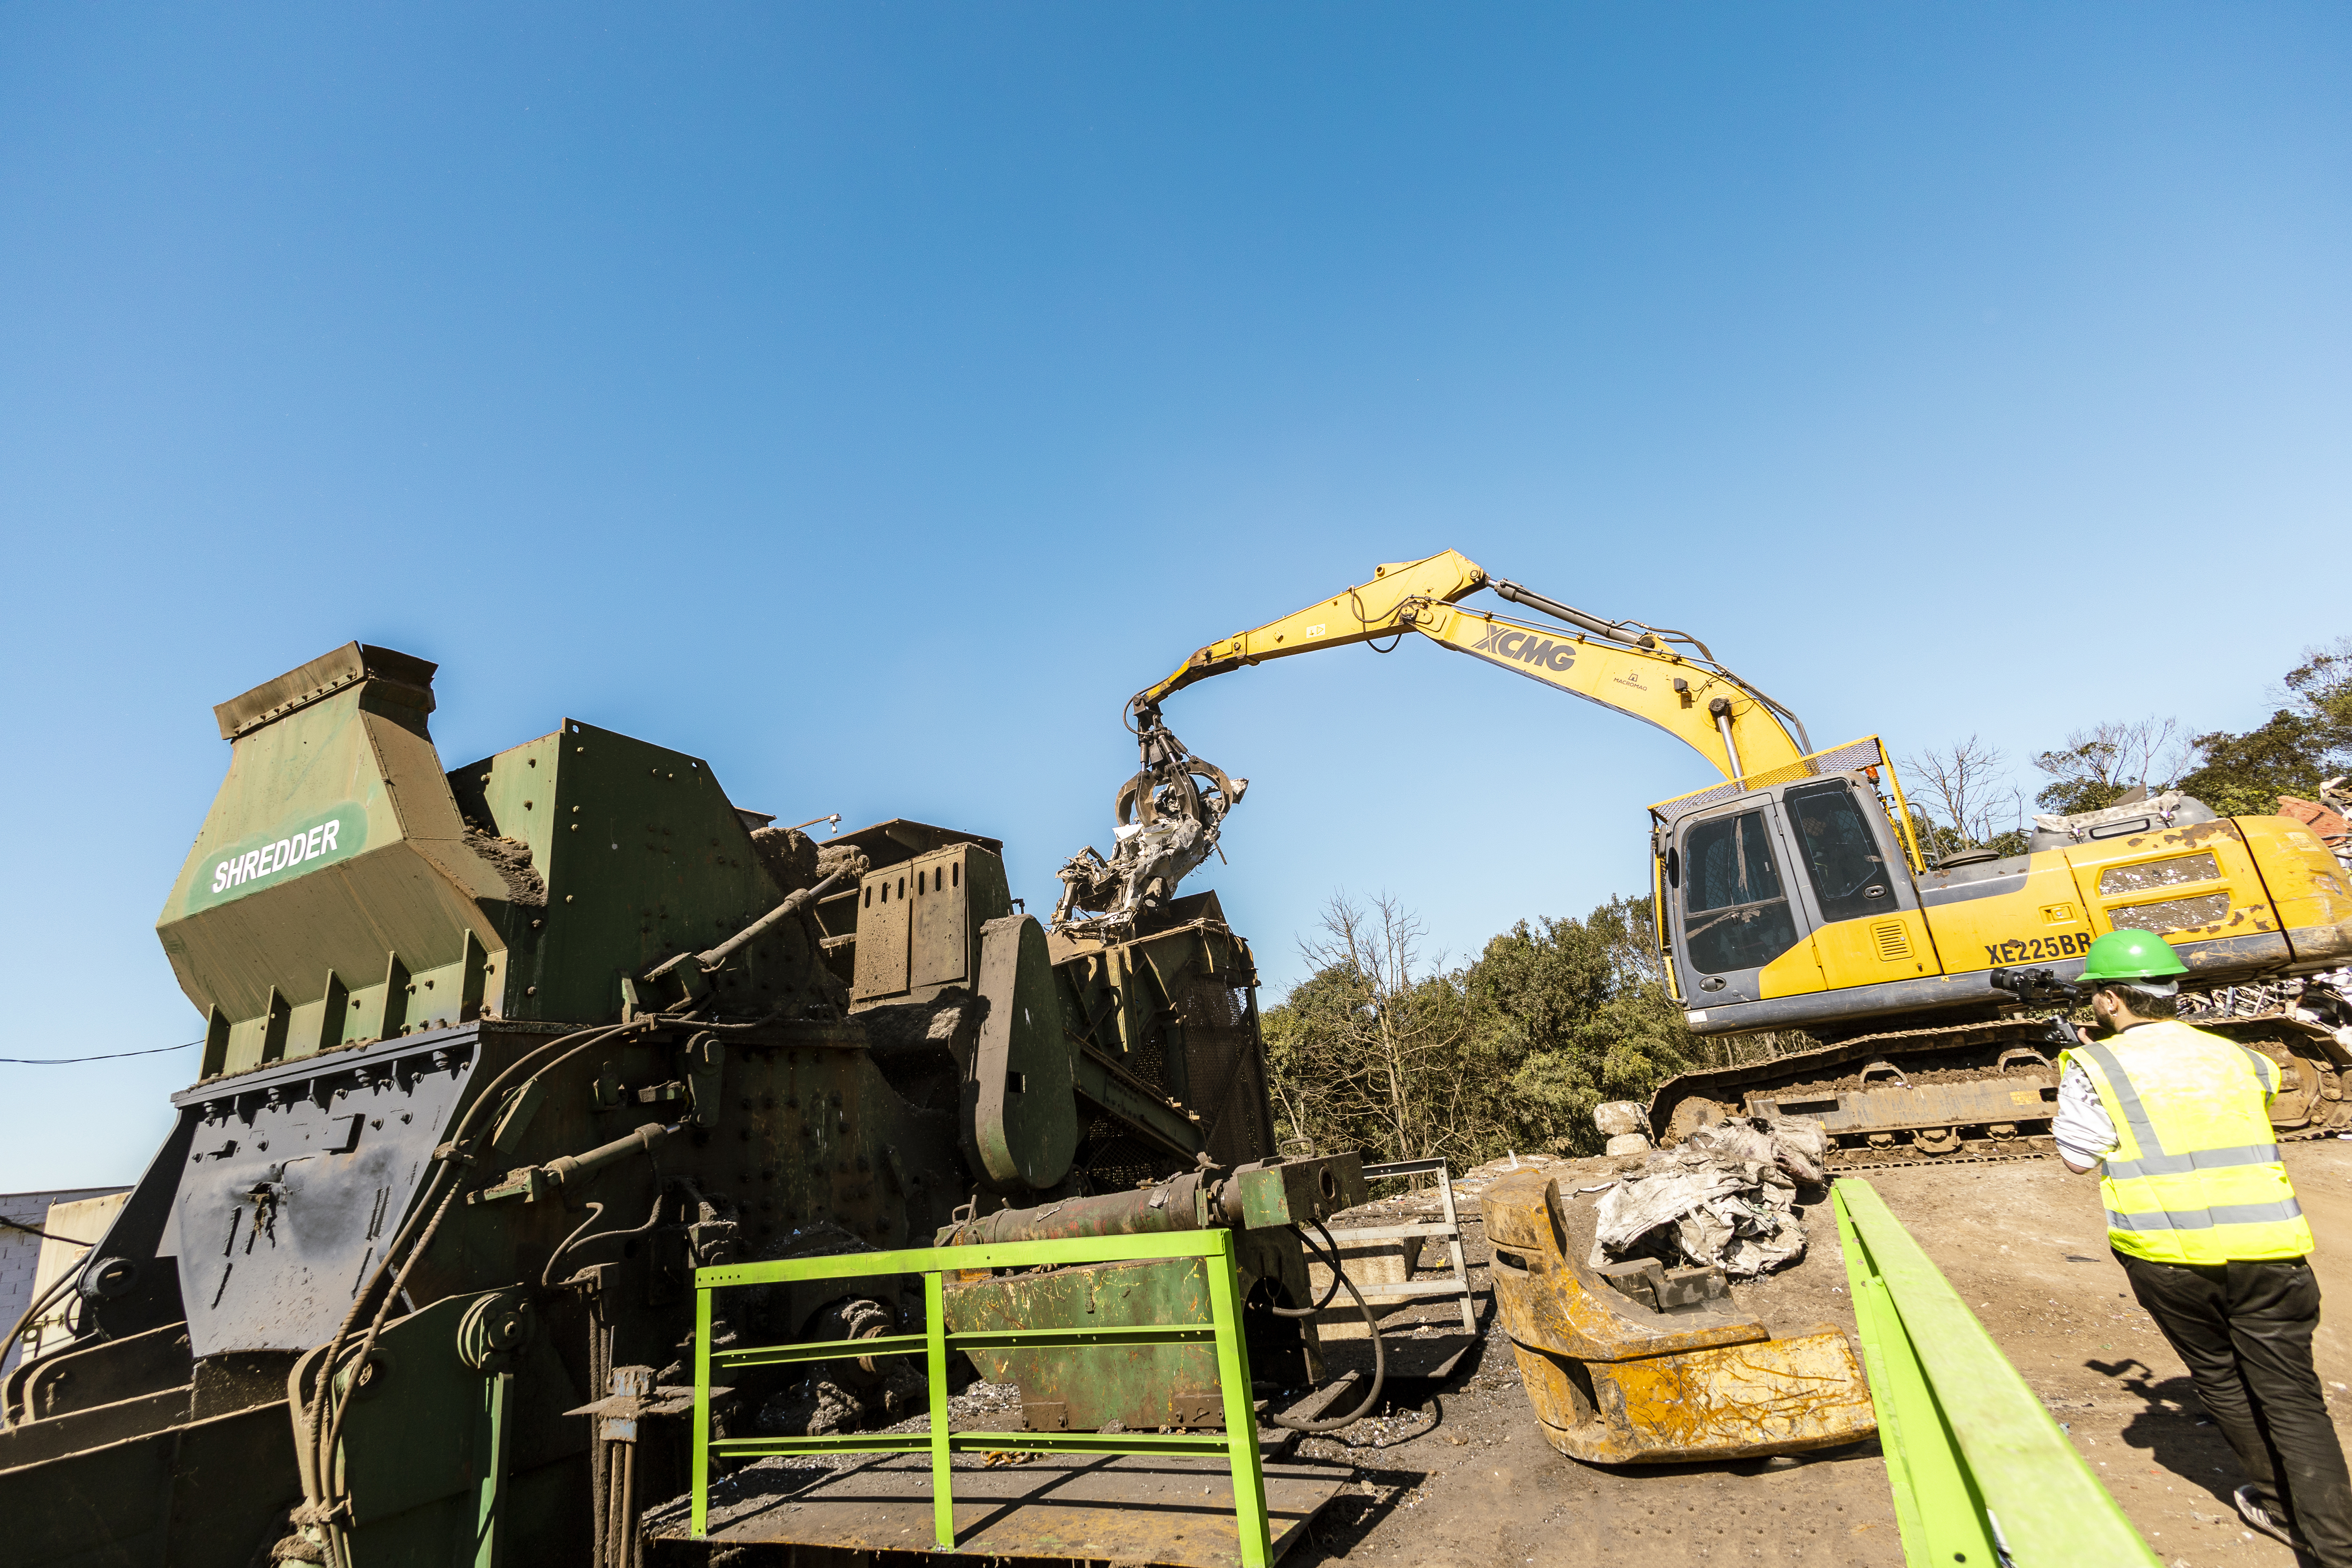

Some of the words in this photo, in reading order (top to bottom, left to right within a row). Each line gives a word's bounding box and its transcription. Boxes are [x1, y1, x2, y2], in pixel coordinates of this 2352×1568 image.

[1470, 623, 1576, 671] XCMG
[1613, 677, 1647, 691] MACROMAQ
[212, 819, 340, 893] SHREDDER
[1985, 932, 2091, 965] XE225BR
